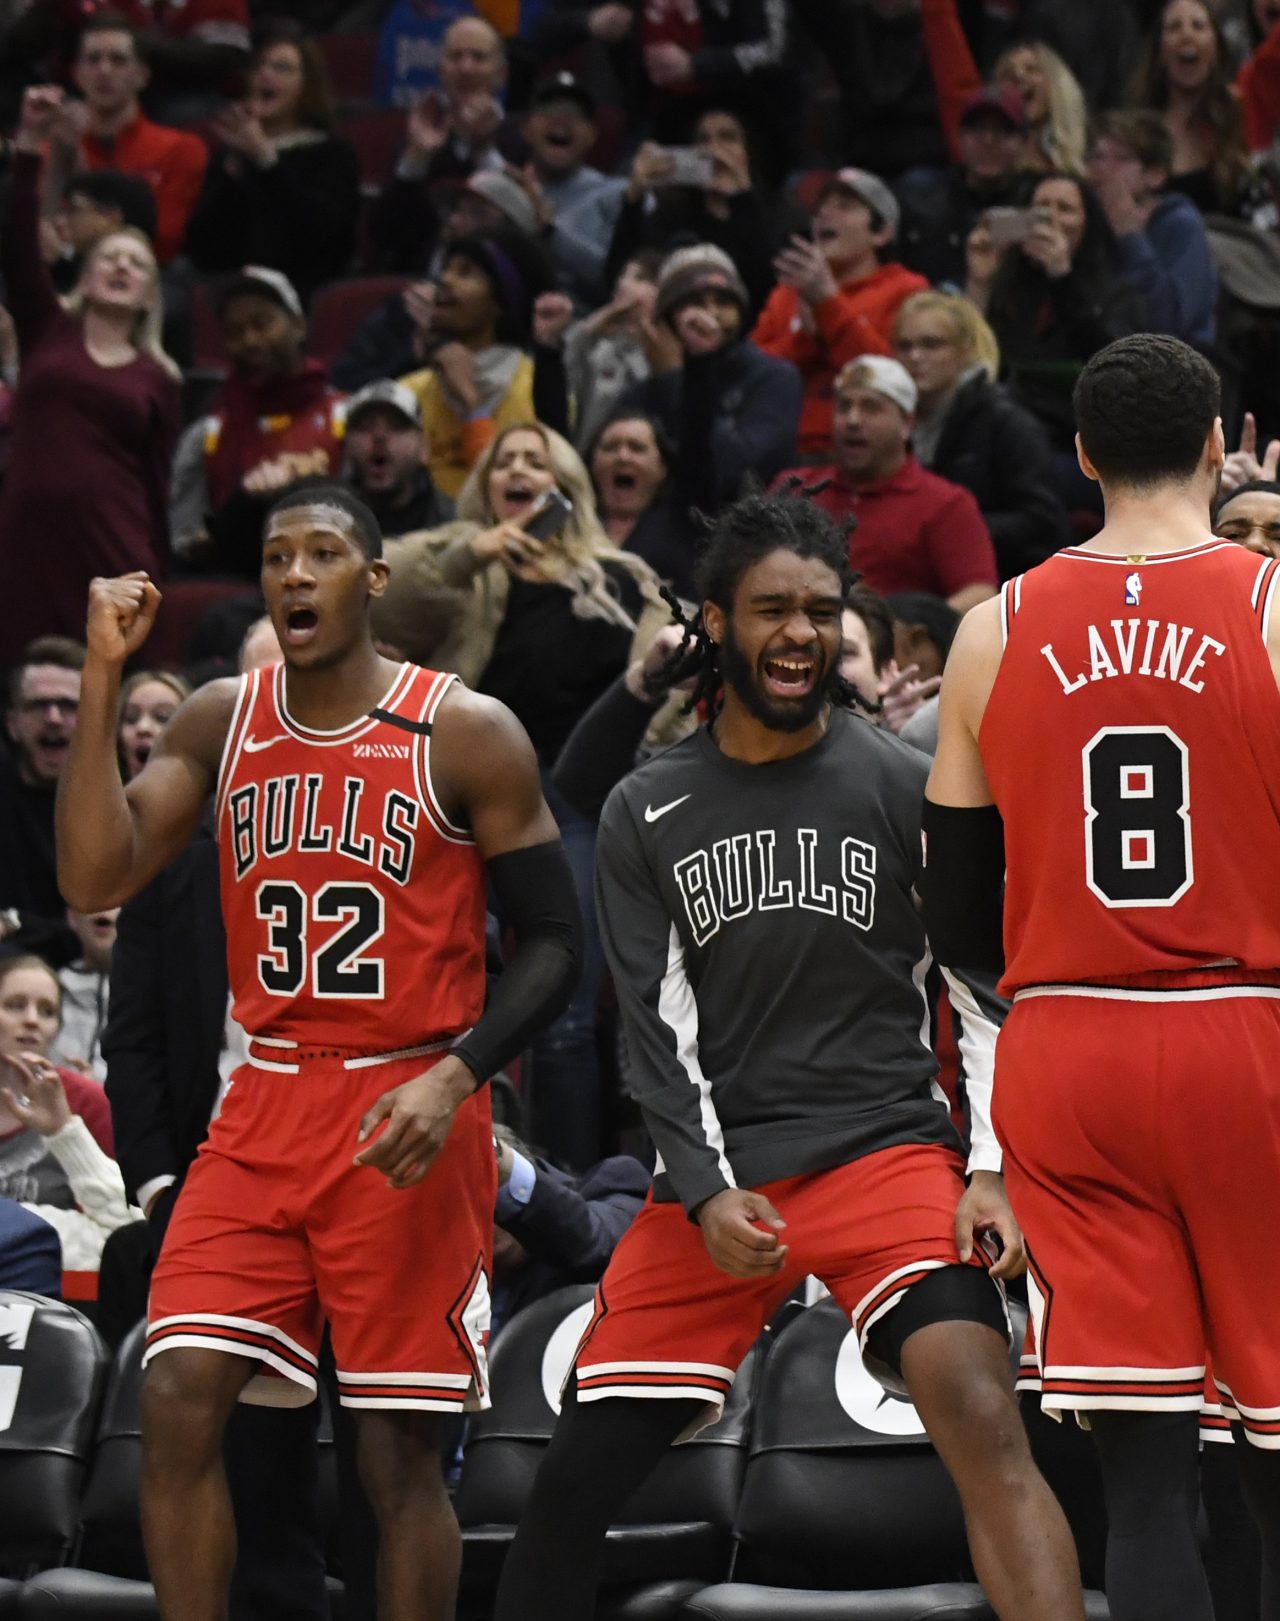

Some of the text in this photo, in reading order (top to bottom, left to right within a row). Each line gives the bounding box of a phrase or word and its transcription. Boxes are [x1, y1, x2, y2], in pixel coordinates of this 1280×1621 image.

[1040, 618, 1226, 695] LAVINE
[229, 774, 420, 887] BULLS
[1081, 725, 1194, 908] 8
[255, 879, 385, 999] 32
[673, 828, 876, 948] BULLS
